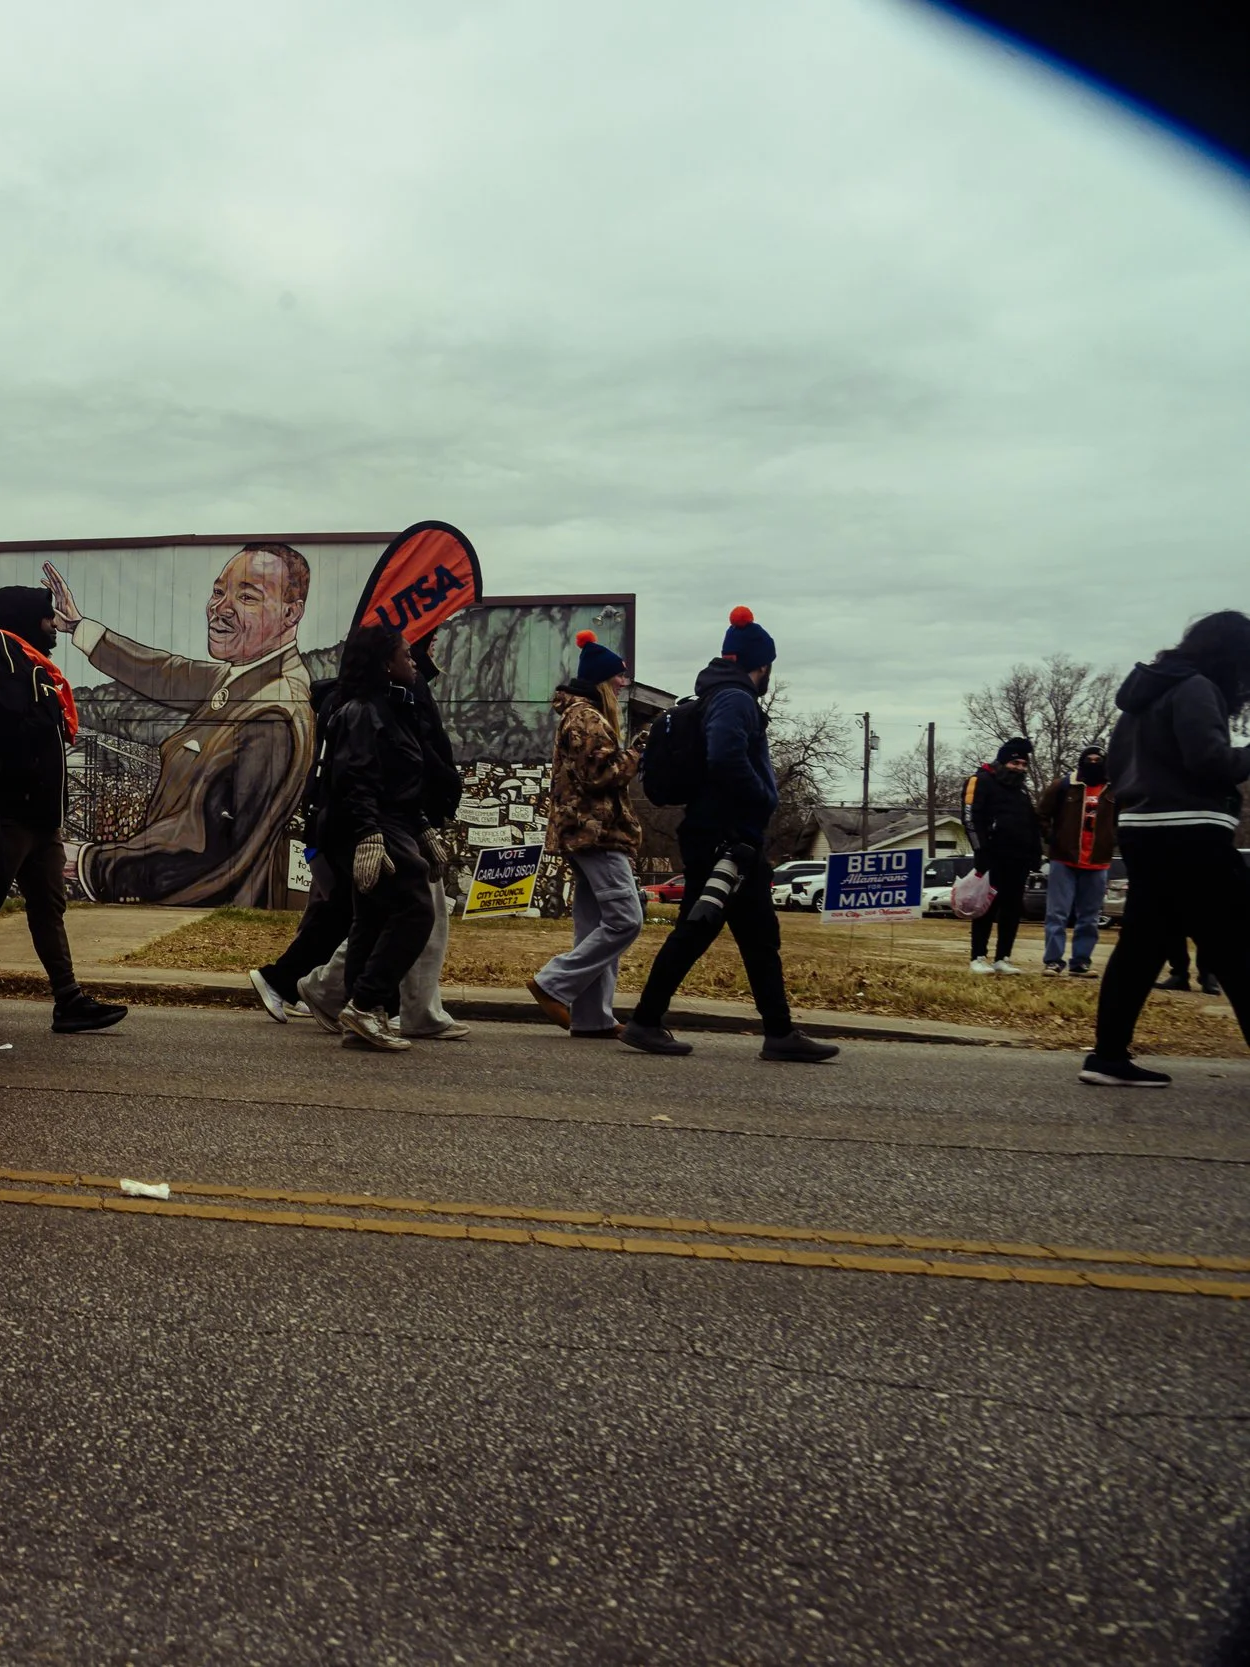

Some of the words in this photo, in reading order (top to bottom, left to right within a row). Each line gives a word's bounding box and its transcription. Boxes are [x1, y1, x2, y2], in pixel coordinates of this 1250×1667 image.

[374, 564, 466, 633] UTSA
[497, 848, 527, 861] VOTE
[847, 852, 907, 873] BETO
[515, 863, 536, 878] SISCO
[840, 872, 909, 884] Altamirano
[476, 890, 493, 900] CITY
[493, 887, 525, 898] COUNCIL
[838, 890, 907, 907] MAYOR
[479, 897, 513, 908] DISTRICT
[512, 896, 519, 905] 2
